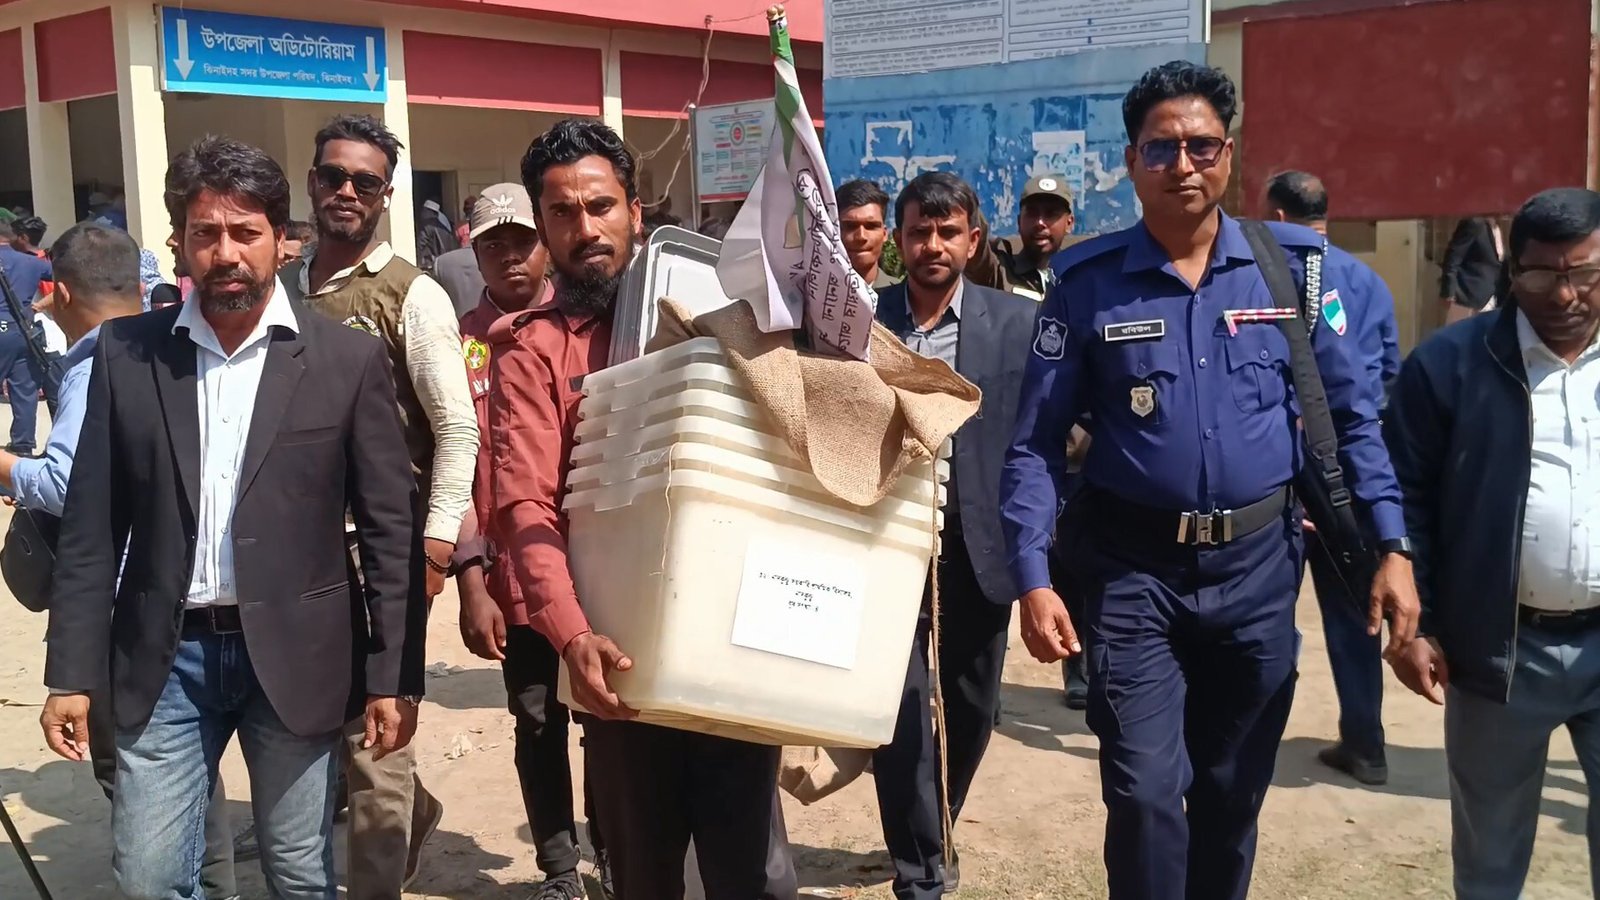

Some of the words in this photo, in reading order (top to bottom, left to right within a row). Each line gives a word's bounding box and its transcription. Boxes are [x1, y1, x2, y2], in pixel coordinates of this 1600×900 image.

[200, 25, 264, 55] উপজেলা
[268, 33, 356, 62] অডিটোরিয়াম
[203, 62, 239, 77] ঝিনাইদহ
[240, 67, 257, 78] সদর
[259, 67, 291, 81] উপজেলা
[490, 205, 516, 215] adidas
